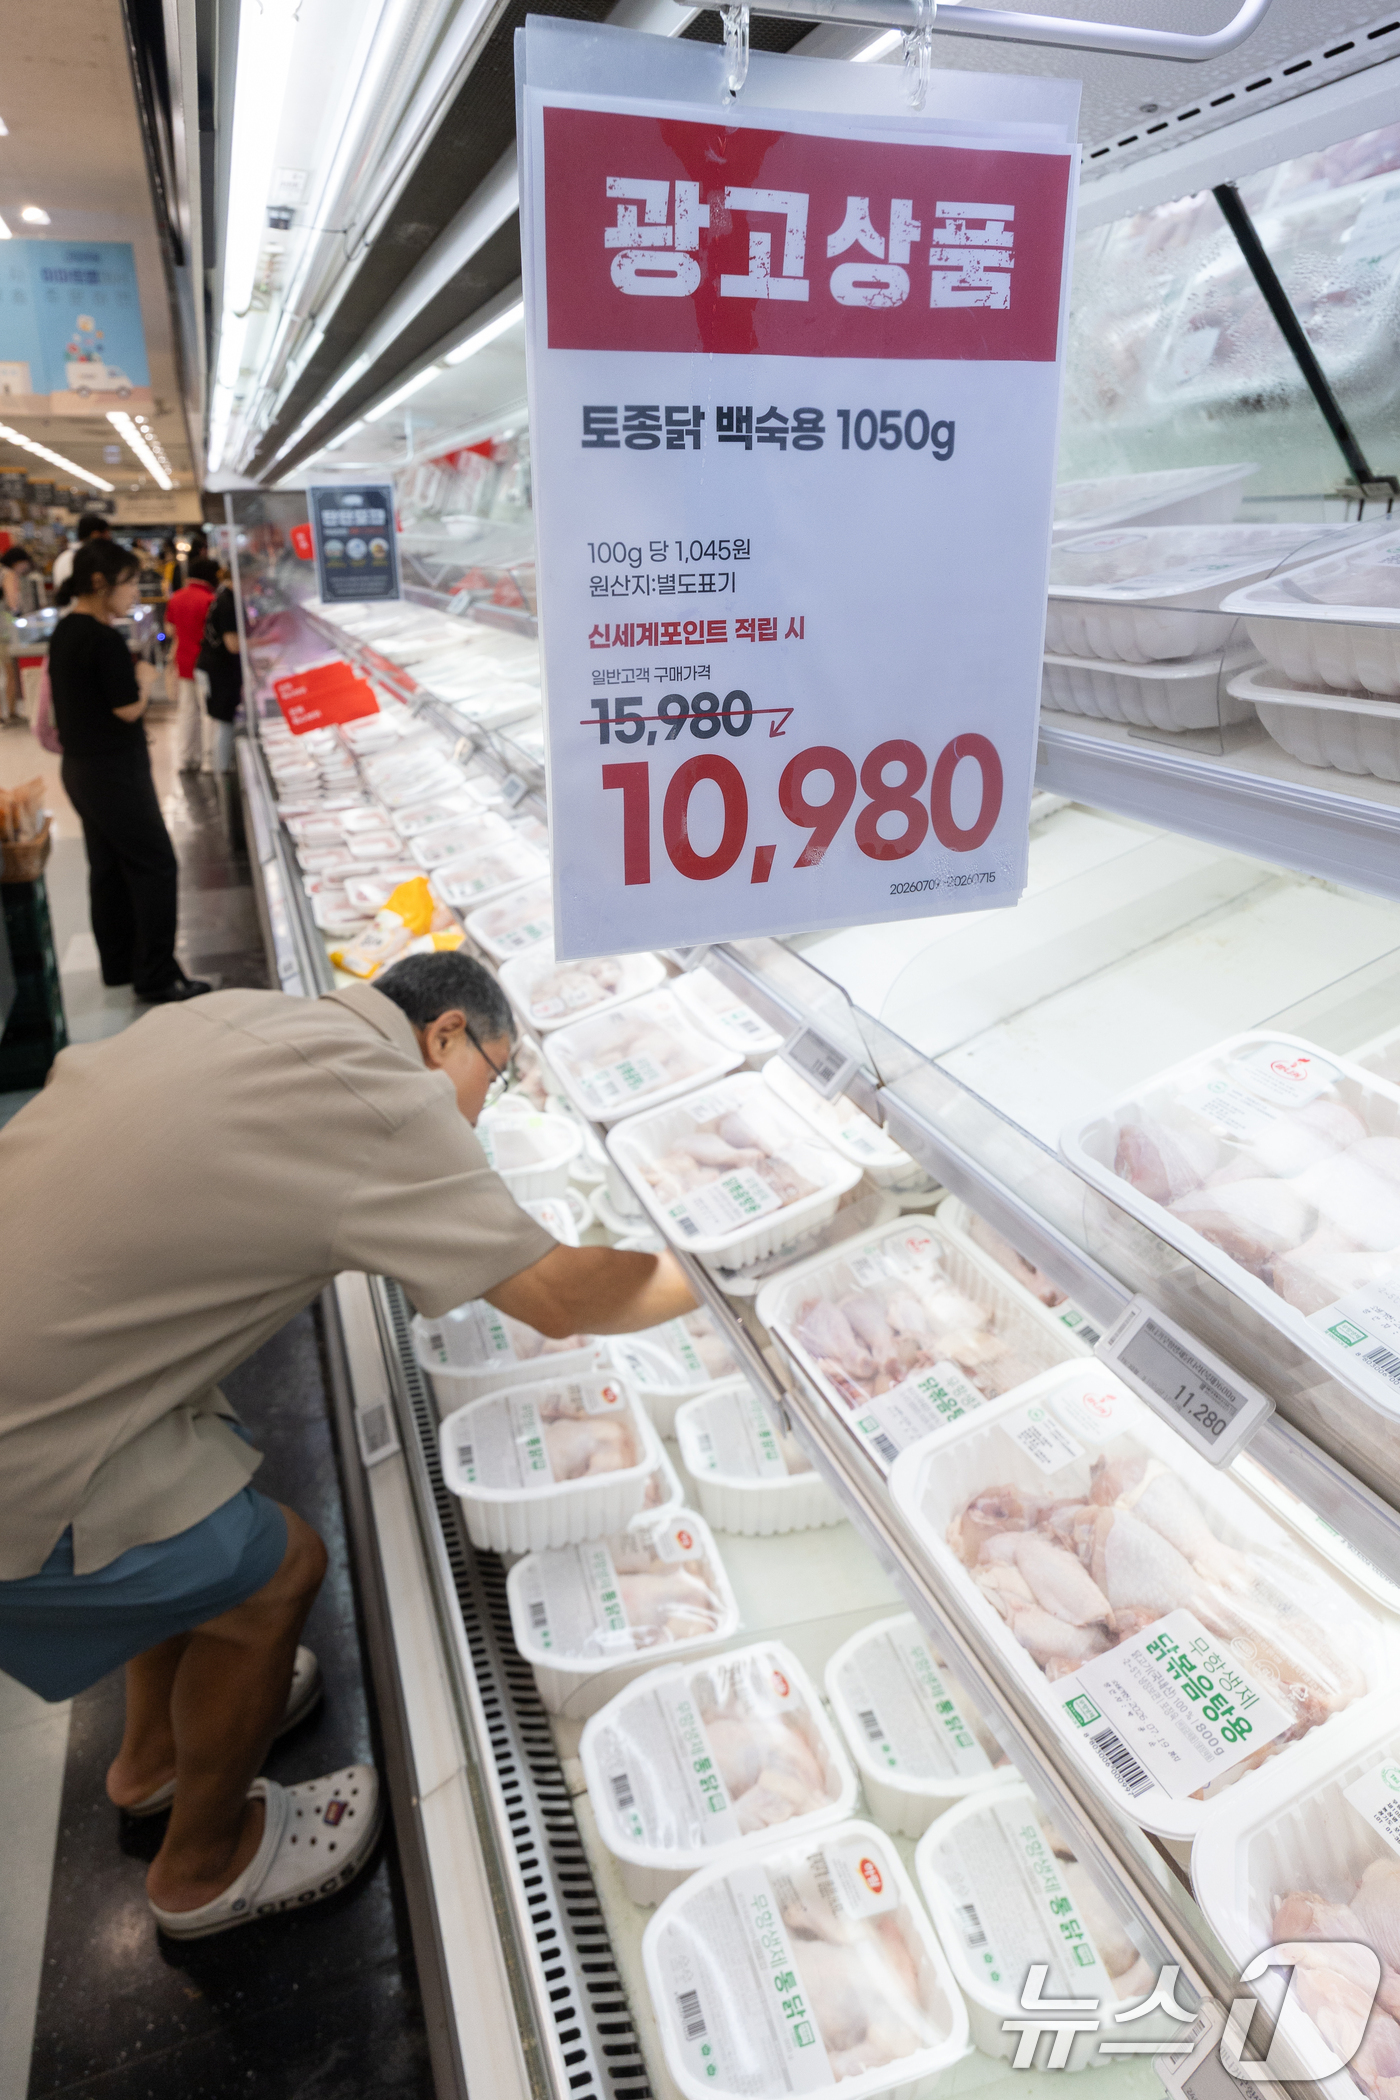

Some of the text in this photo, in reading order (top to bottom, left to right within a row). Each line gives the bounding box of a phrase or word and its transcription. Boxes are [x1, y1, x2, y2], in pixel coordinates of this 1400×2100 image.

[604, 176, 1015, 310] 광고상품
[581, 405, 956, 461] 토종닭 백숙용 1050g
[587, 538, 751, 567] 100g 당 1,045원
[588, 572, 737, 598] 원산지:별도표기
[588, 615, 806, 649] 신세계포인트 적립 시
[591, 664, 711, 685] 일반고객 구매가격
[590, 689, 753, 746] 15,980
[601, 732, 1004, 886] 10,980
[1174, 1384, 1227, 1436] 11,280
[1146, 1632, 1253, 1743] 닭볶음탕용
[1189, 1637, 1260, 1710] 무항생제
